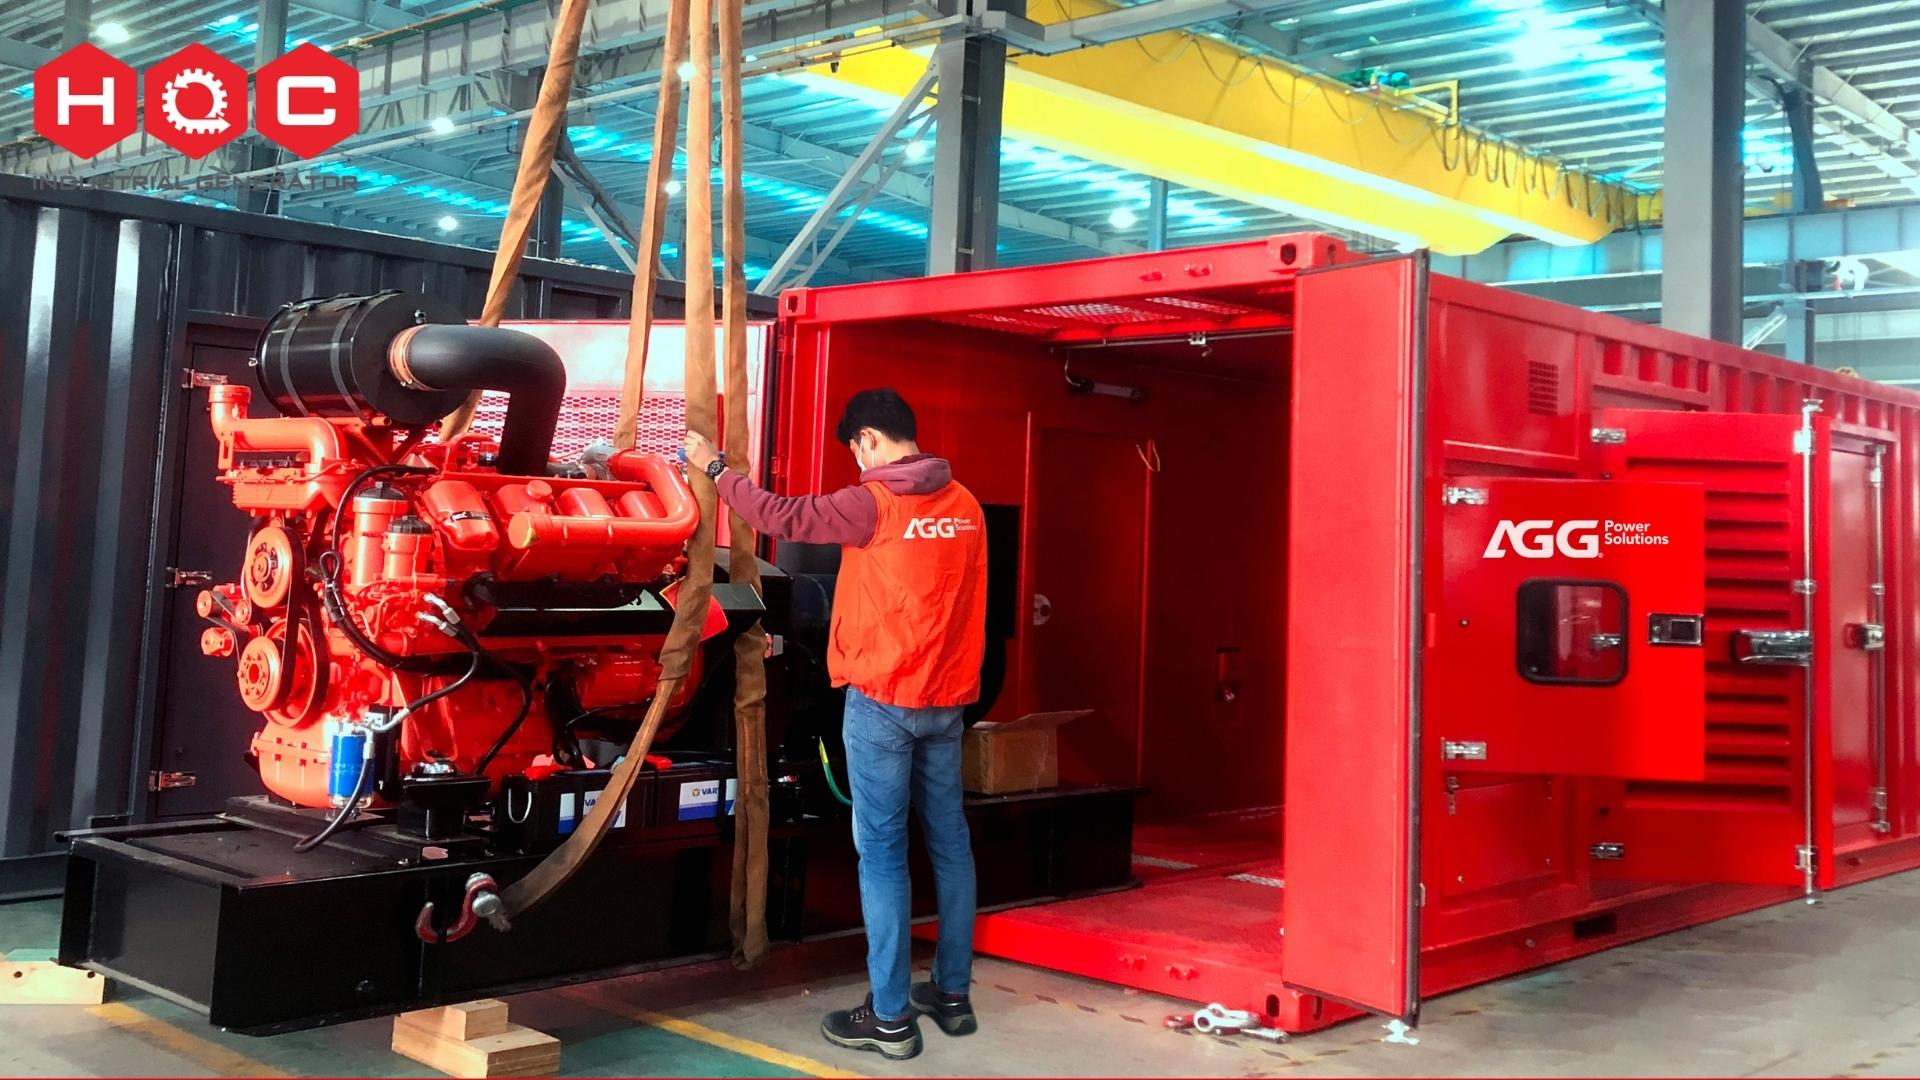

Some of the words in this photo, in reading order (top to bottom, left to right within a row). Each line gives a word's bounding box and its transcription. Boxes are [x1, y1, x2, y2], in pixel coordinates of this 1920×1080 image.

[903, 517, 956, 539] AGG
[1604, 520, 1651, 532] Power
[1482, 519, 1600, 559] AGG
[1604, 532, 1669, 545] Solutions
[702, 786, 719, 796] VAR
